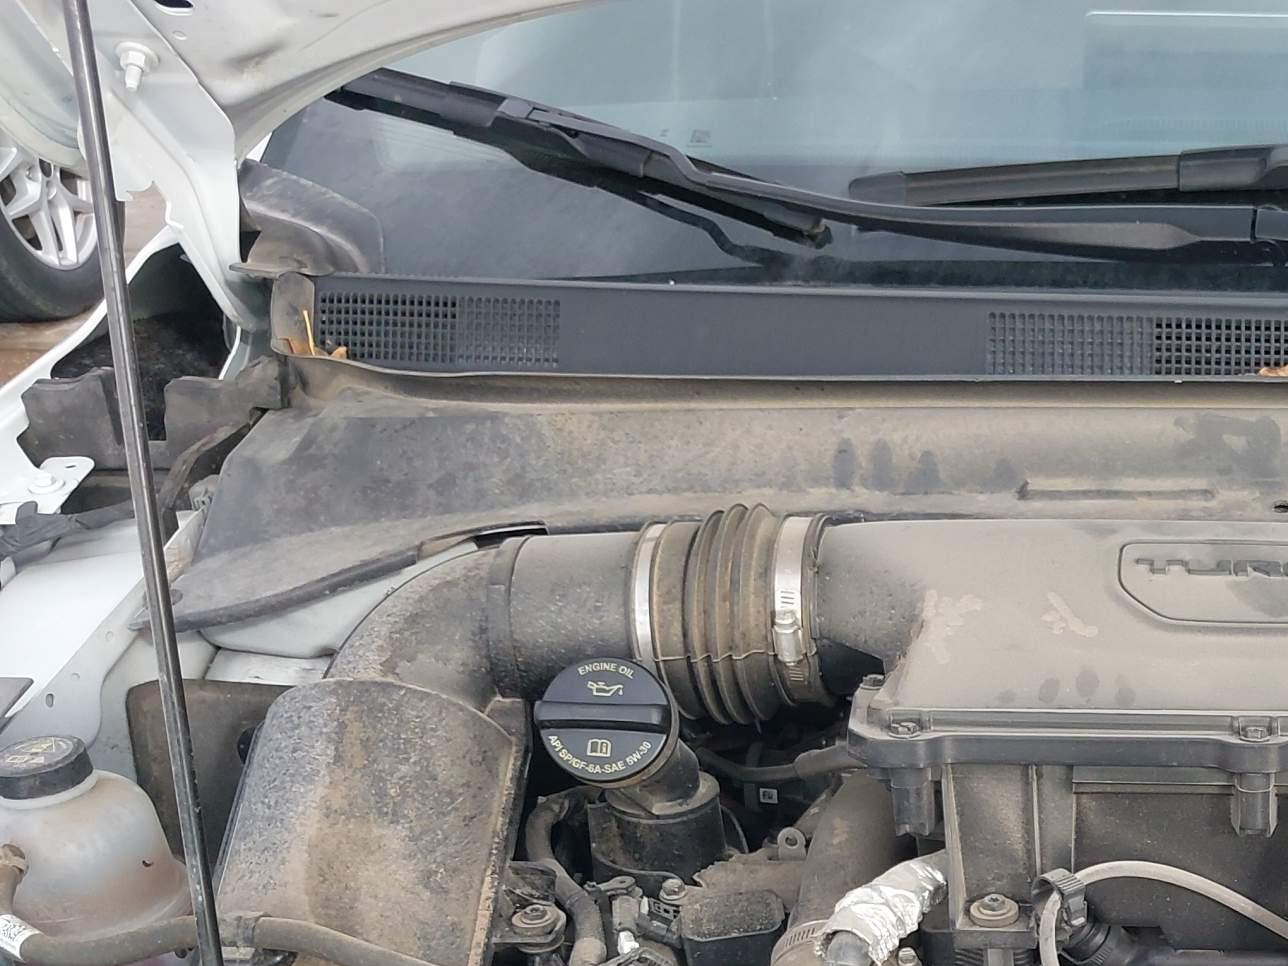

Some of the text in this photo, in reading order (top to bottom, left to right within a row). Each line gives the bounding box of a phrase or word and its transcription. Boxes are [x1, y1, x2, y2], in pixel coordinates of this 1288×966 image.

[577, 662, 634, 679] ENGINE OIL
[548, 735, 652, 774] API SP/GF-6A-SAE 5W-30
